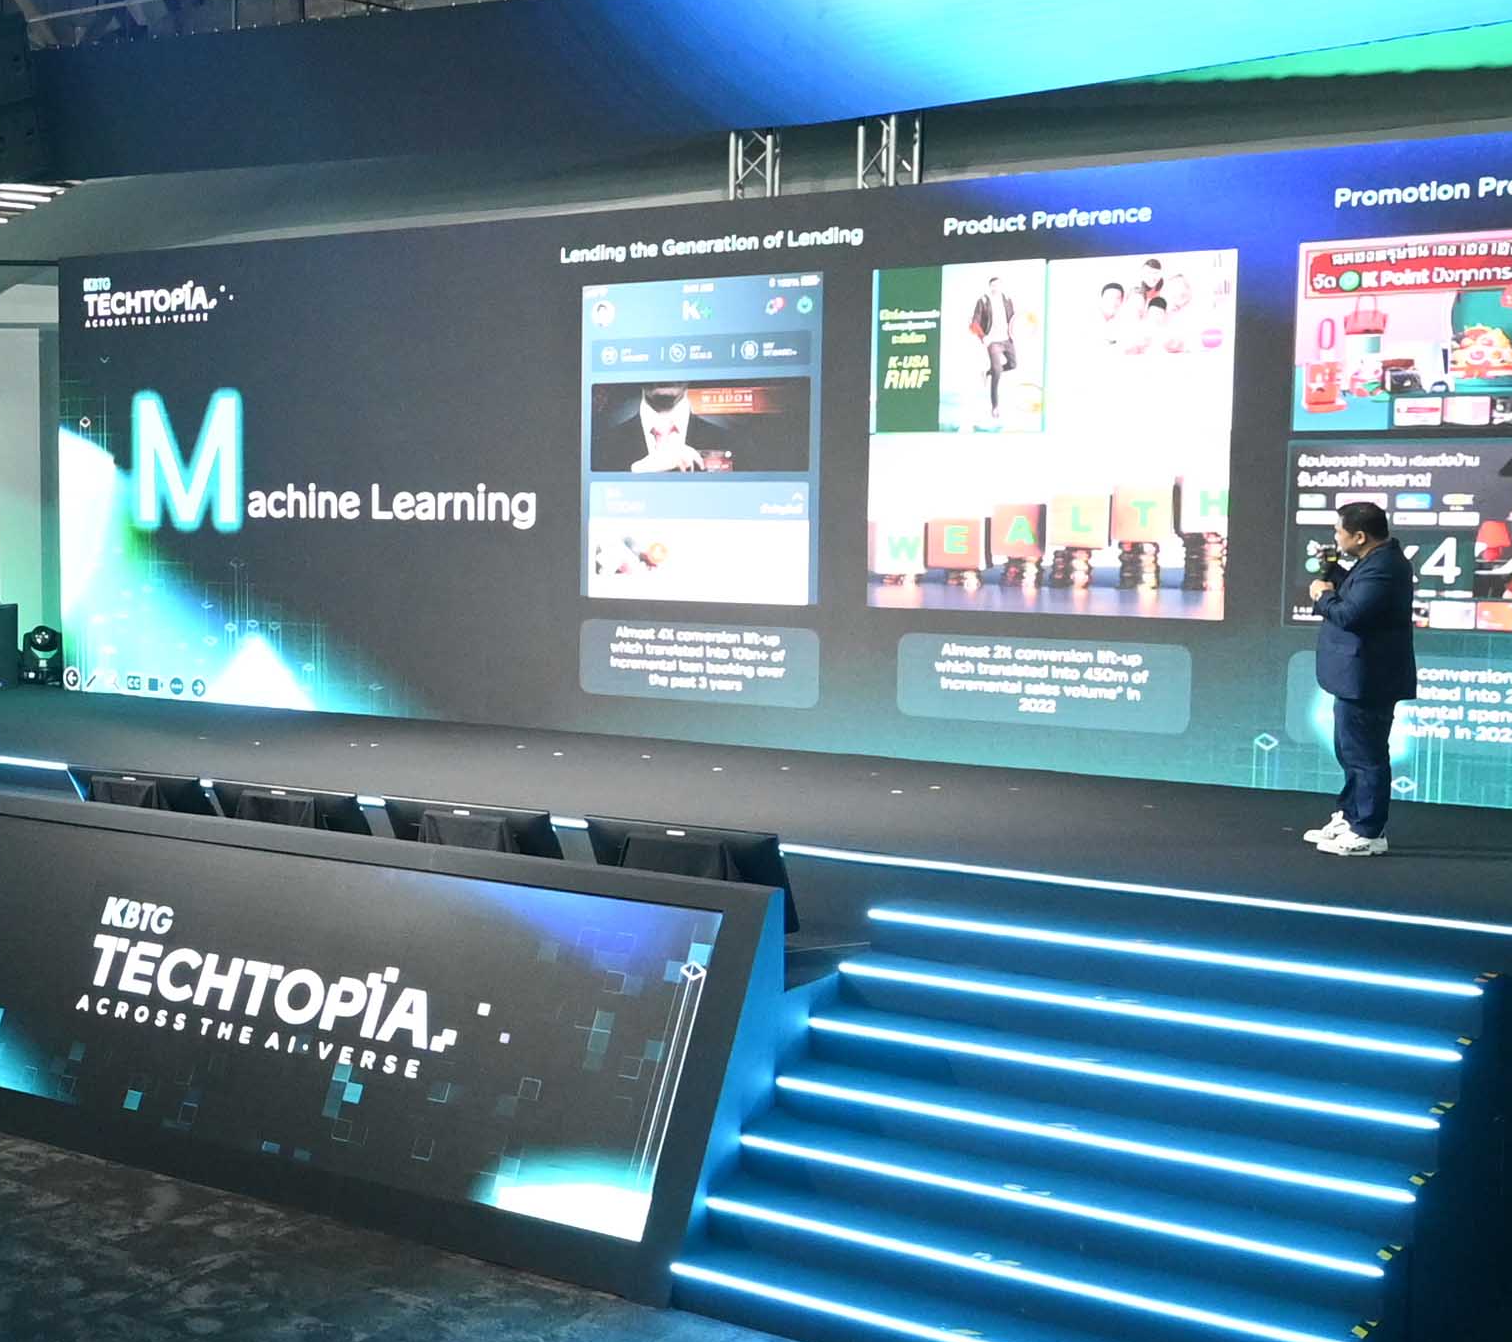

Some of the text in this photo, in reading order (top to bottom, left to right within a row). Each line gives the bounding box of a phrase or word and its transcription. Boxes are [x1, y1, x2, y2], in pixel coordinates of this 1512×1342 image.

[1334, 180, 1470, 208] Promotion
[943, 205, 1152, 237] Product Preference
[560, 226, 864, 264] Lending the Generation of Lending
[1381, 268, 1430, 287] Point
[84, 317, 127, 328] ACROSS
[131, 315, 151, 325] THE
[884, 368, 932, 390] RMF
[371, 482, 538, 530] Learning
[616, 626, 656, 640] Almost
[676, 630, 741, 644] conversion
[610, 641, 643, 654] which
[941, 642, 991, 659] Almost
[1014, 647, 1093, 663] conversion
[935, 660, 975, 674] which
[977, 662, 1049, 678] translated
[1051, 665, 1080, 680] into
[1131, 669, 1150, 684] of
[940, 676, 1022, 694] incremental
[1126, 686, 1141, 702] in
[1465, 687, 1501, 703] into
[1455, 725, 1472, 740] in
[100, 896, 174, 935] KBTG
[75, 994, 187, 1031] ACROSS
[200, 1017, 252, 1045] THE
